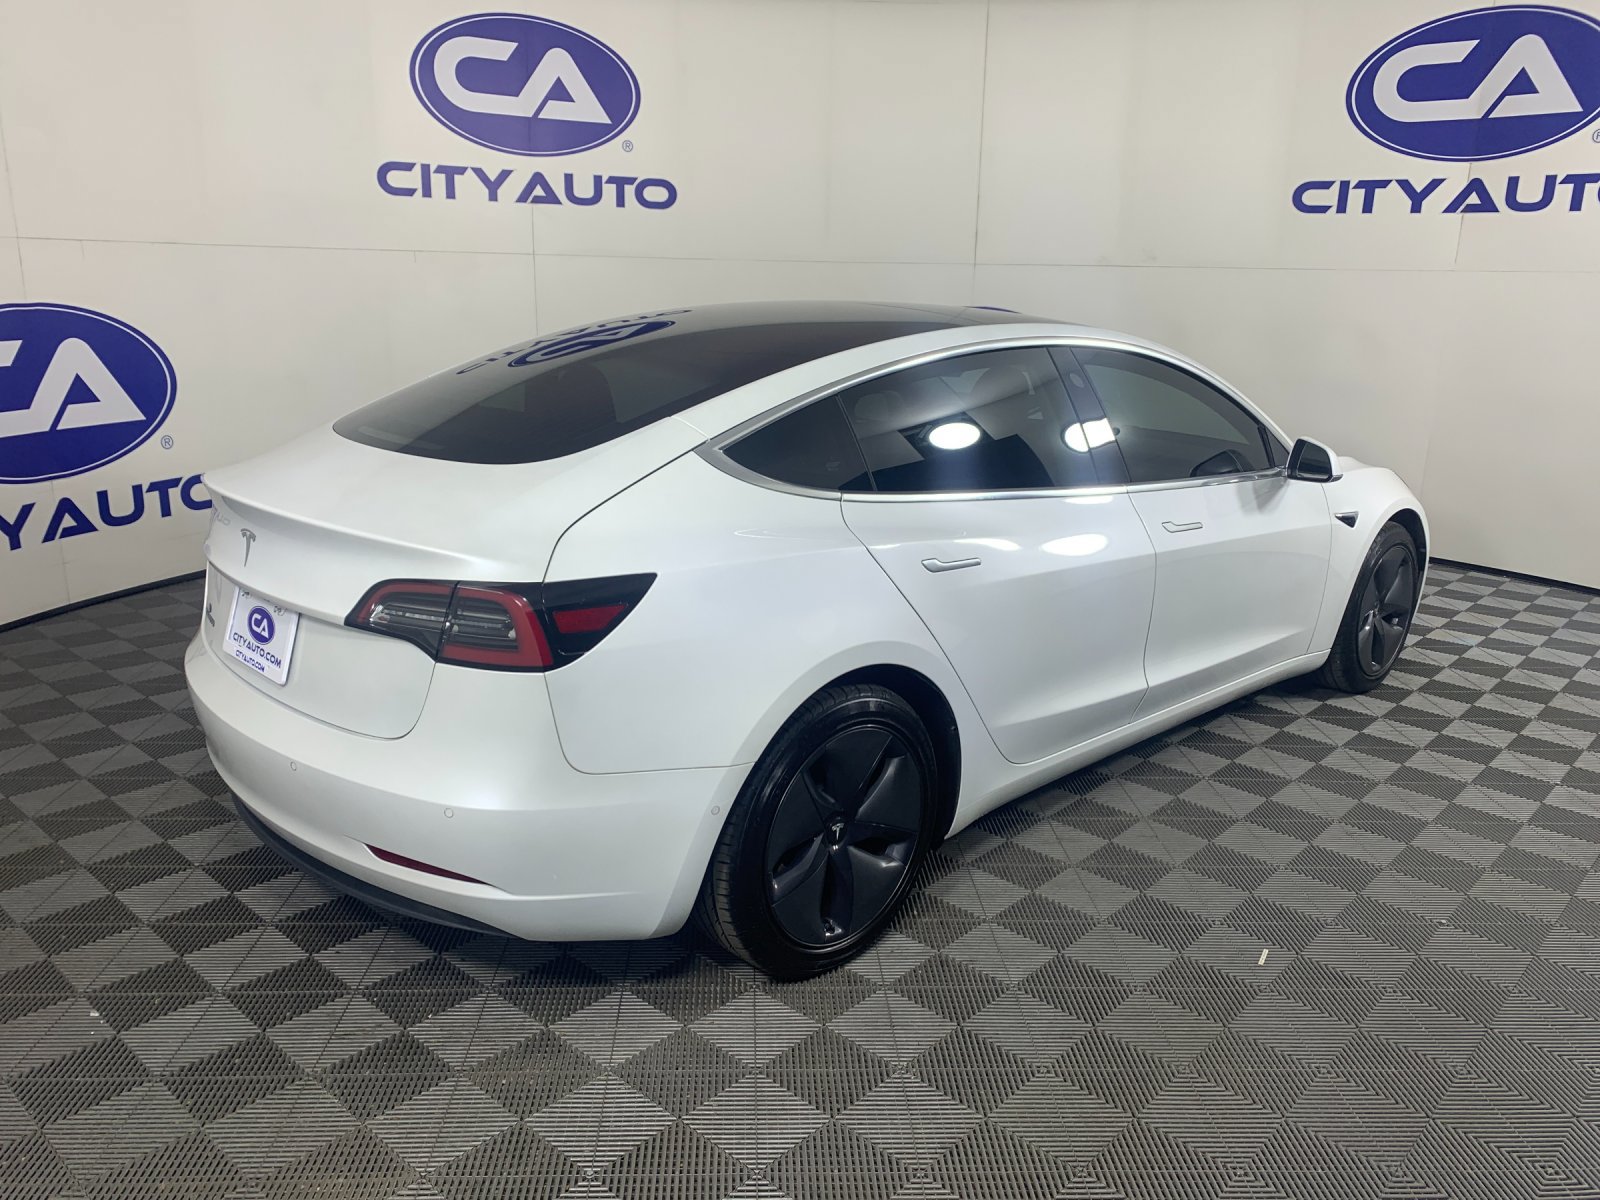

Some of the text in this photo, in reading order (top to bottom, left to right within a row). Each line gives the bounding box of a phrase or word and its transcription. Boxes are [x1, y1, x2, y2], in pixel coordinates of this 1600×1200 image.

[433, 35, 613, 124] CA
[1373, 33, 1584, 123] CA
[1442, 172, 1600, 214] AUT
[252, 614, 268, 638] CA
